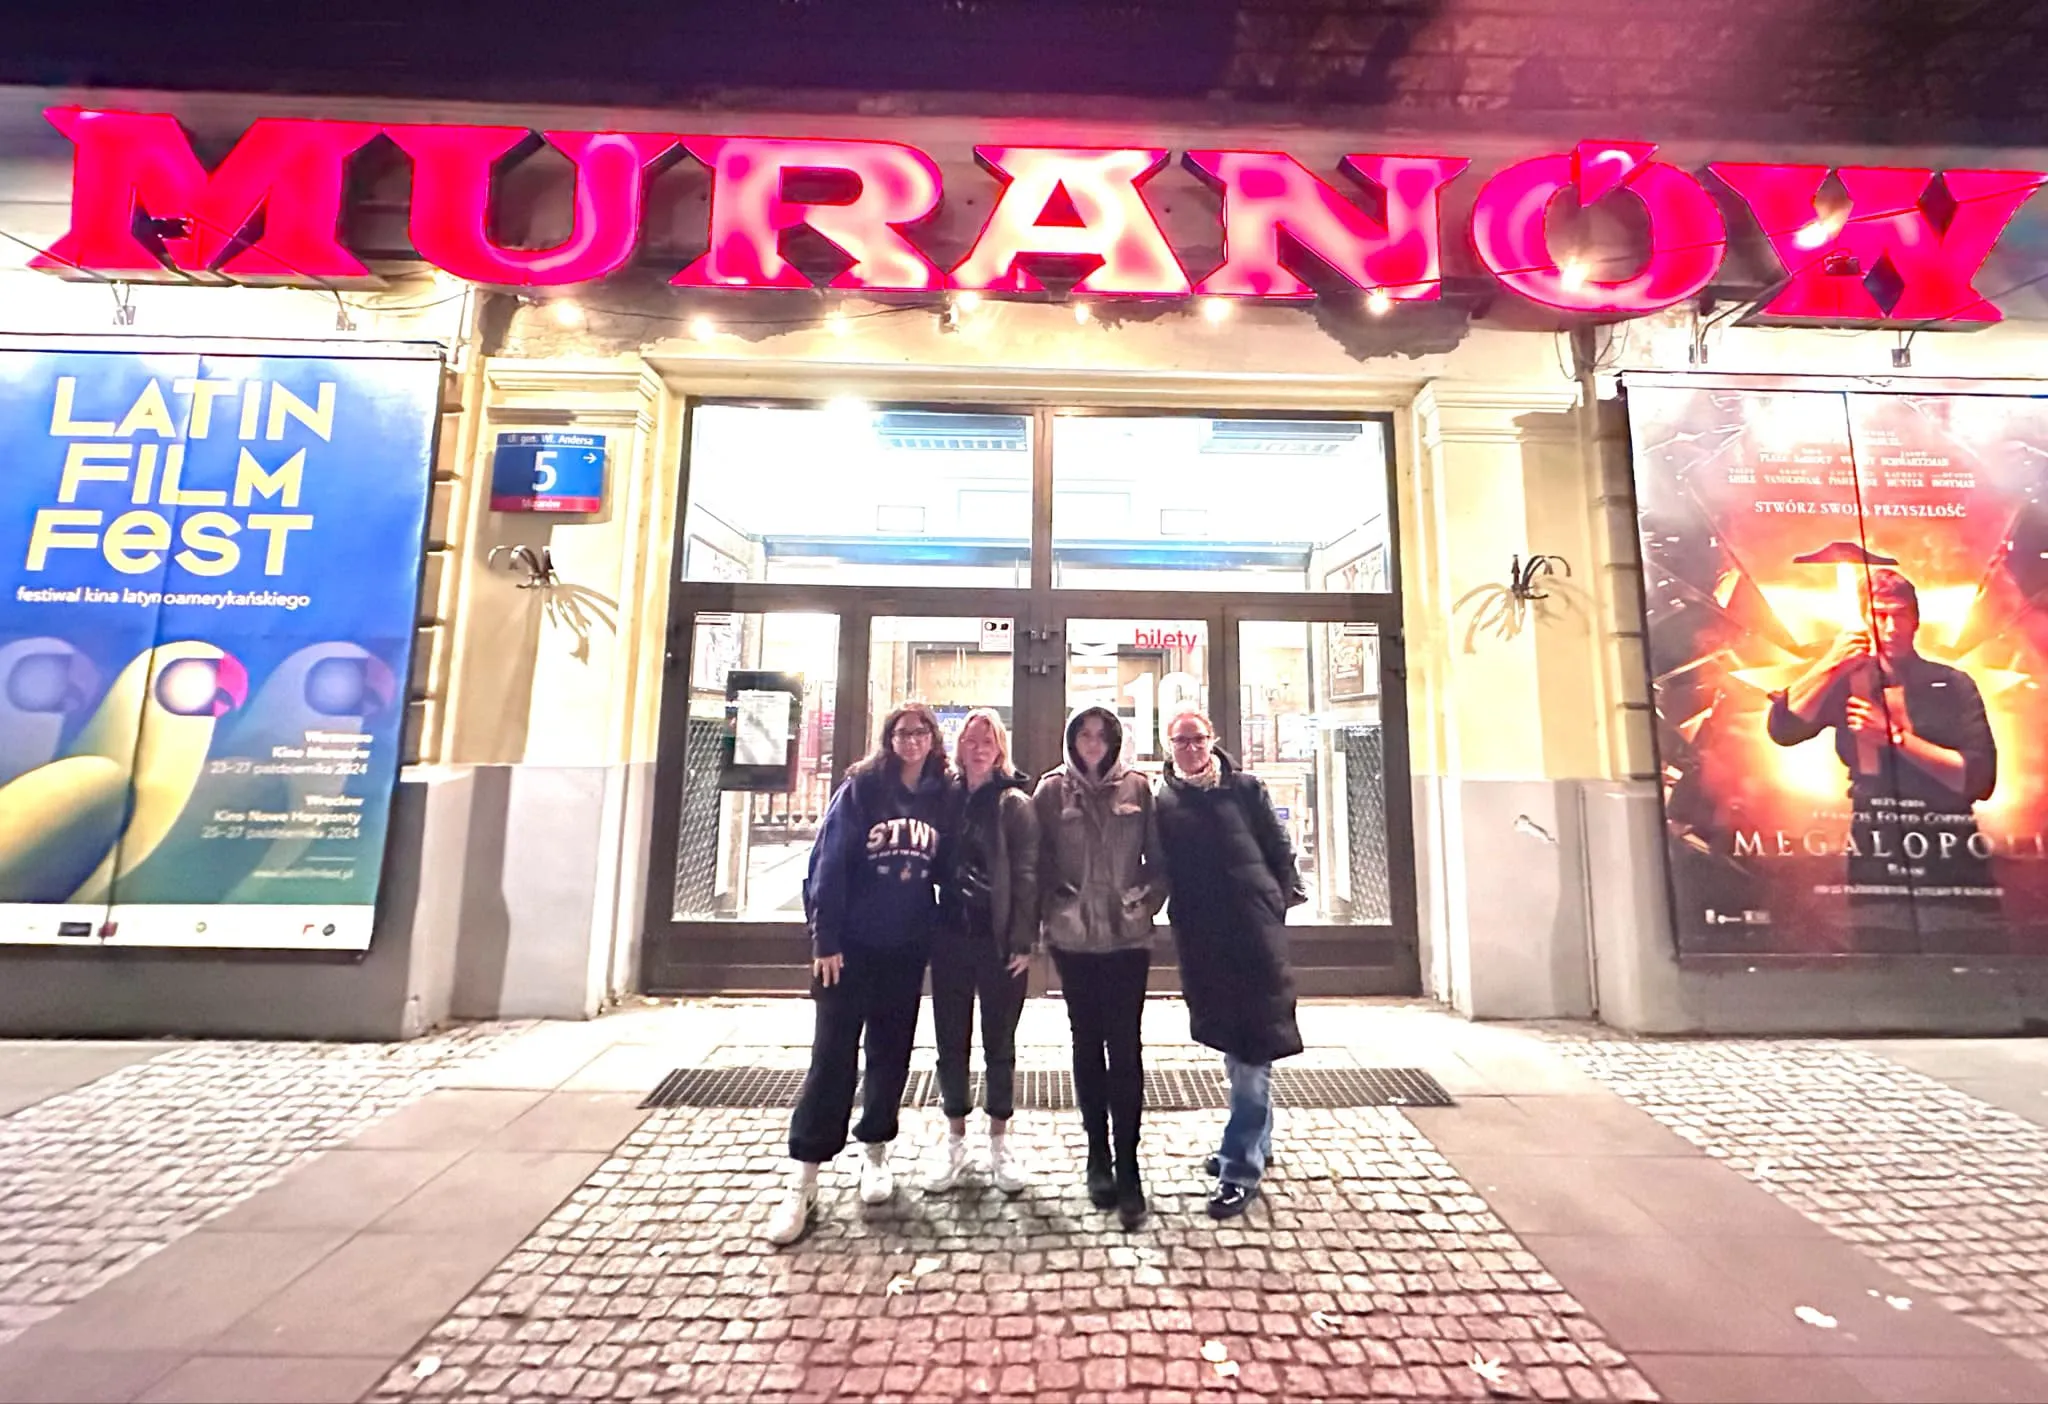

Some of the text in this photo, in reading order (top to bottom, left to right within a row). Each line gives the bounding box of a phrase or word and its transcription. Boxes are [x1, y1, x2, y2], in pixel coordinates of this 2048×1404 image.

[28, 106, 2048, 324] MURANÓW
[49, 376, 337, 442] LATIN
[558, 434, 594, 446] Andersa
[57, 443, 307, 508] FILM
[531, 450, 559, 492] 5
[1755, 499, 1816, 515] STWÓRZ
[16, 586, 80, 603] festiwal
[85, 588, 119, 603] kina
[1134, 628, 1198, 655] bilety
